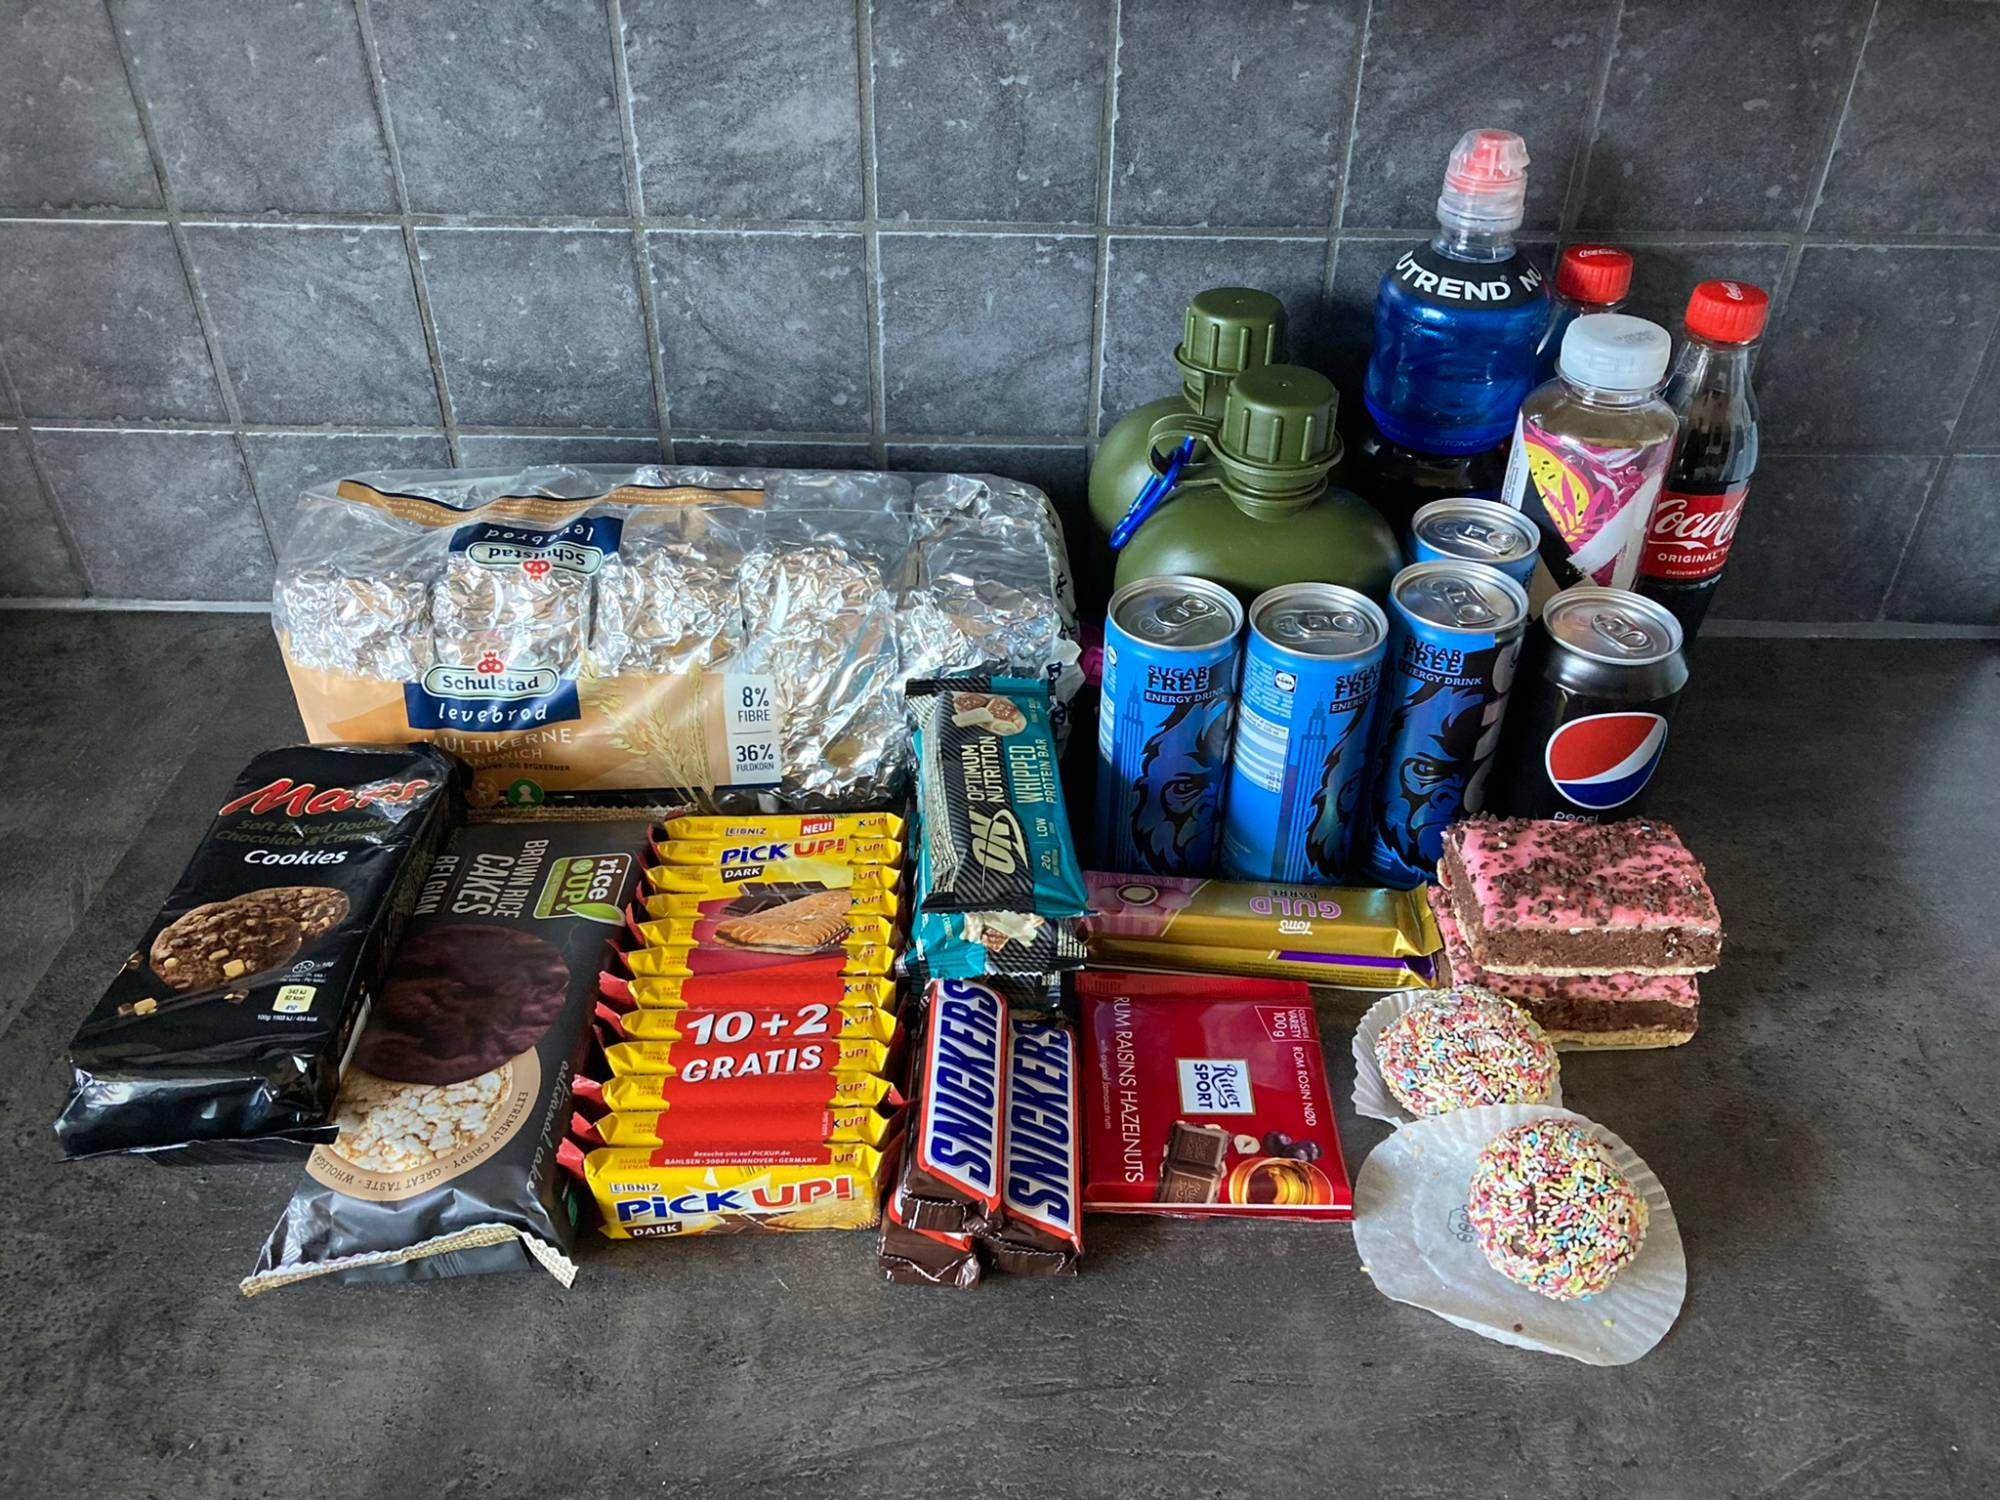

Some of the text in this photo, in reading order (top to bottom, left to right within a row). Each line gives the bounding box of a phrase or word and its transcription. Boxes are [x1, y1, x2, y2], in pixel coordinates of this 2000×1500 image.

[1396, 250, 1511, 301] UTREND
[488, 547, 586, 566] Schulstad
[1657, 551, 1718, 564] ORIGINAL
[1147, 664, 1209, 680] SUGAR
[1444, 677, 1483, 686] DRINK
[443, 675, 540, 692] Schulstad
[1147, 674, 1209, 692] FREE
[742, 686, 770, 708] 8%
[1145, 691, 1193, 704] ENERGY
[737, 709, 772, 722] FIBRE
[423, 727, 573, 754] ULTIKERNE
[1034, 738, 1049, 758] BAR
[735, 743, 774, 763] 36%
[735, 762, 775, 772] FULDKORN
[961, 743, 985, 801] OPTIMUM
[978, 735, 1006, 803] NUTRITION
[1008, 745, 1045, 804] WHIPPED
[1039, 760, 1057, 804] PROTEIN
[218, 777, 430, 817] Mars
[724, 826, 768, 838] LEIBNIZ
[802, 820, 833, 835] NEU!
[1035, 817, 1047, 837] LOW
[793, 837, 847, 857] UP!
[244, 850, 349, 866] Cookies
[493, 839, 550, 919] BROWN RICE
[588, 859, 623, 900] rice
[724, 867, 762, 879] DARK
[452, 853, 515, 916] CAKES
[1248, 895, 1342, 920] GULD
[1277, 919, 1313, 936] Toms
[1273, 1011, 1287, 1030] 100
[680, 1045, 825, 1083] GRATIS
[931, 979, 999, 1190] SNICKERS
[1113, 996, 1145, 1184] RUM RAISINS HAZELNUTS
[1194, 1063, 1214, 1109] SPORT
[1211, 1063, 1241, 1109] Ritter
[1292, 1046, 1318, 1127] ROM ROSIN NØD
[493, 1090, 529, 1146] EXTREMELY
[1008, 1018, 1070, 1224] SNICKERS
[452, 1142, 490, 1170] CRISPY
[365, 1179, 401, 1192] TASTE
[405, 1168, 442, 1188] GREAT
[609, 1182, 660, 1194] LEIBNIZ
[751, 1176, 852, 1209] UP!
[633, 1223, 679, 1237] DARK
